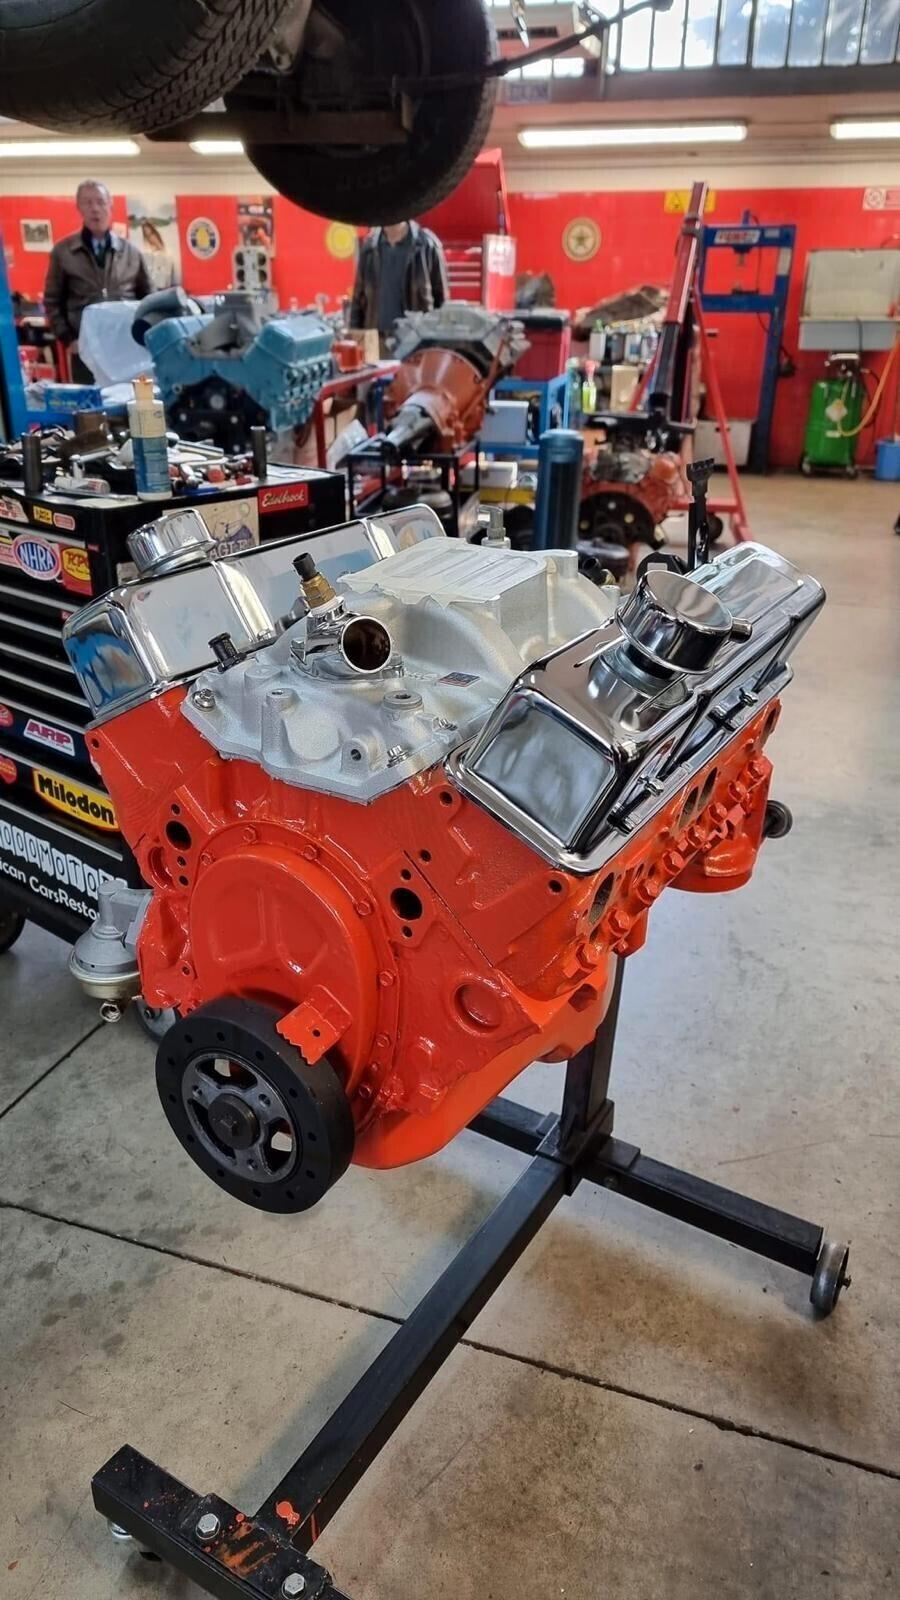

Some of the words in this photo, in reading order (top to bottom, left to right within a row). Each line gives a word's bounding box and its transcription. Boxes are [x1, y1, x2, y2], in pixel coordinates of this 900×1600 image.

[262, 489, 305, 508] Edelbrock
[18, 541, 57, 571] NHRA
[27, 720, 71, 746] ARP
[37, 773, 115, 825] Milodon
